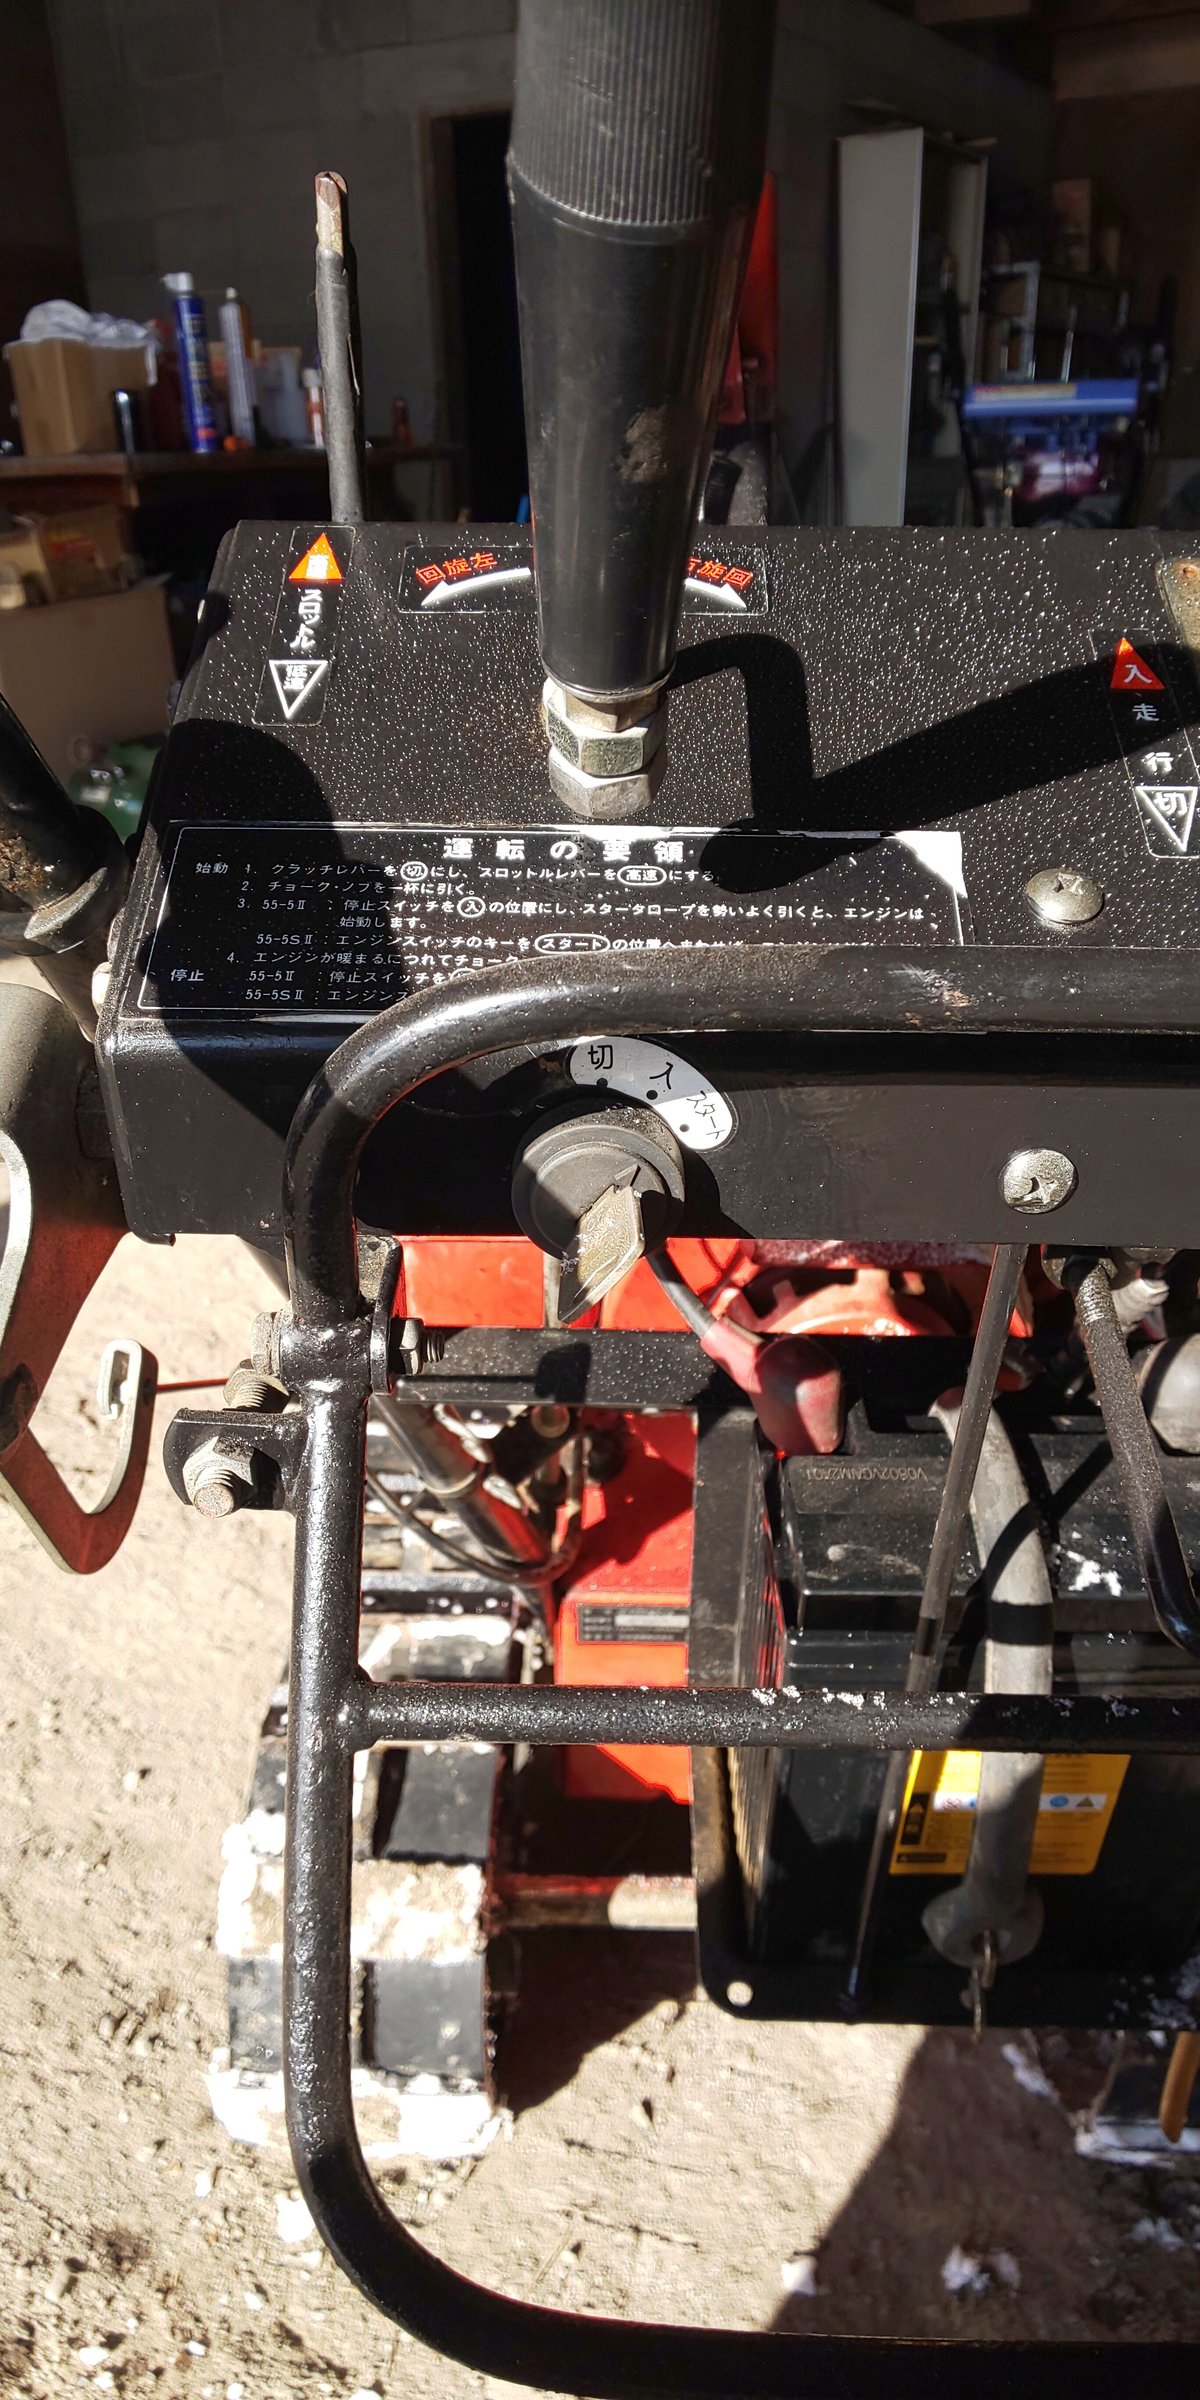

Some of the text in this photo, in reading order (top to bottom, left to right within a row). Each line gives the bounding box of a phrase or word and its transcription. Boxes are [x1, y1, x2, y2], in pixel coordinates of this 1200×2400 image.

[290, 588, 324, 649] スロットル
[1123, 663, 1153, 684] 入
[1154, 791, 1187, 815] 切
[195, 862, 229, 874] 始動
[241, 880, 254, 892] 2.
[339, 916, 427, 929] 始動します。
[170, 969, 205, 982] 停止
[587, 1044, 614, 1070] 切
[649, 1061, 674, 1090] 入
[686, 1090, 726, 1140] スタート
